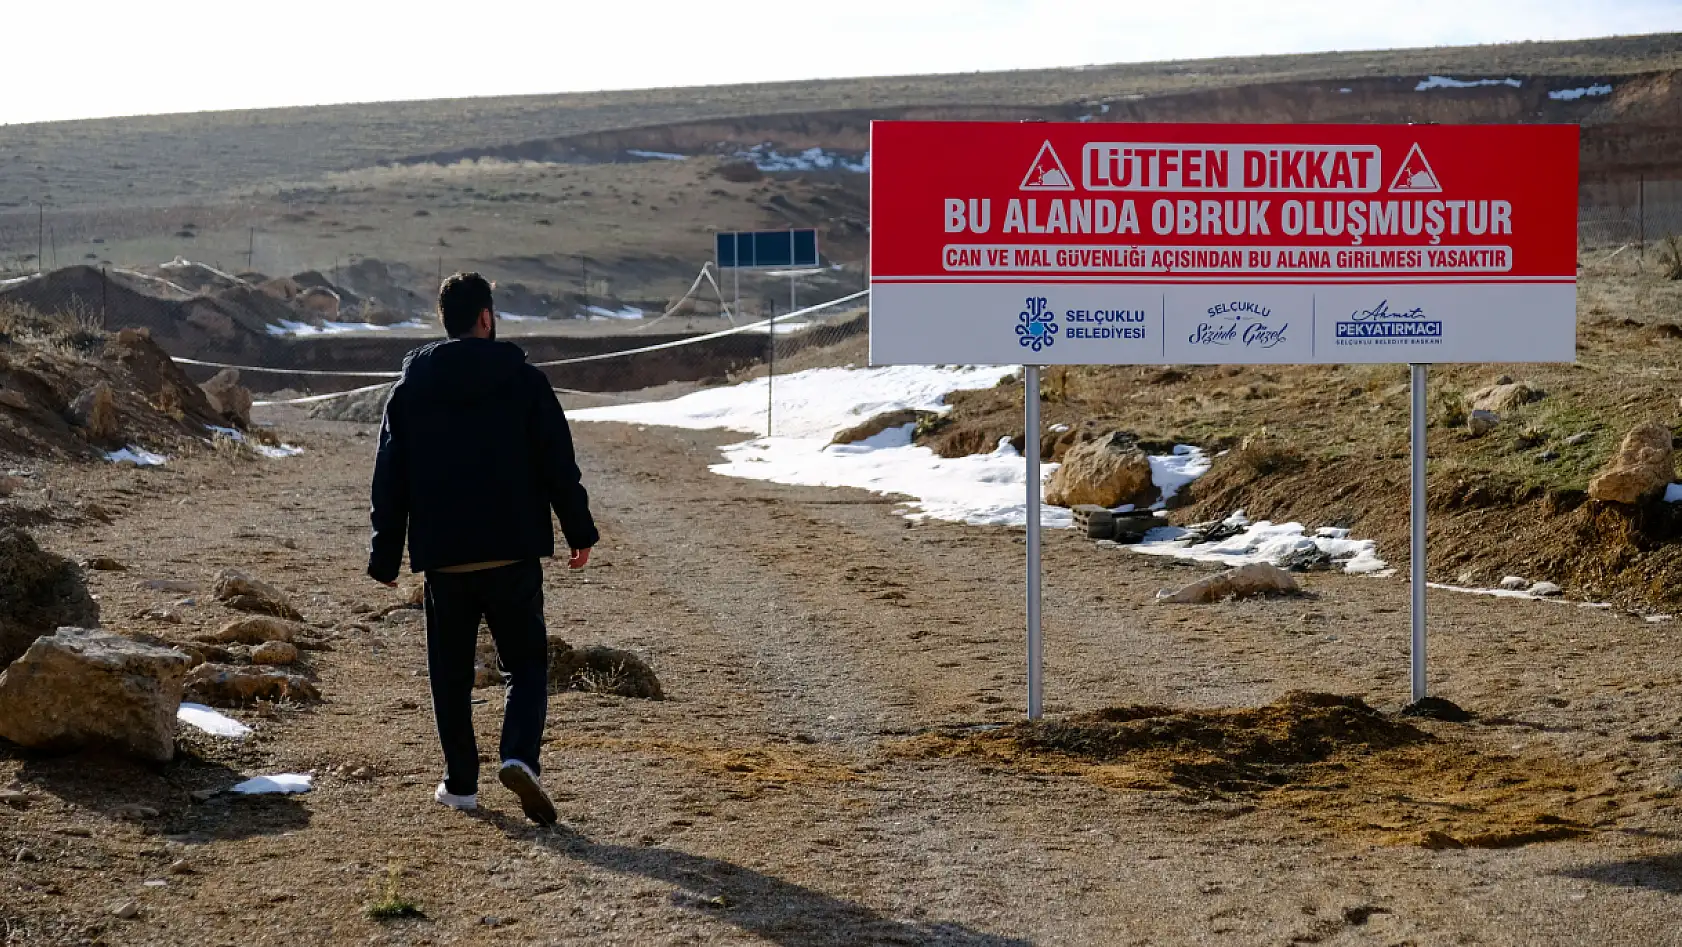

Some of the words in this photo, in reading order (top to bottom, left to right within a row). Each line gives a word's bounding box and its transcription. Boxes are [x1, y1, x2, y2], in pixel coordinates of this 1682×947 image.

[1090, 148, 1228, 187] LÜTFEN
[944, 199, 991, 233] BU
[1002, 199, 1140, 234] ALANDA
[1151, 199, 1271, 235] OBRUK
[1281, 199, 1512, 245] OLUŞMUŞTUR
[946, 249, 982, 267] CAN
[987, 249, 1009, 267] VE
[1014, 249, 1051, 267] MAL
[1151, 249, 1243, 272] AÇISINDAN
[1249, 250, 1271, 268] BU
[1276, 250, 1331, 269] ALANA
[1427, 250, 1506, 268] YASAKTIR
[1065, 310, 1145, 325] SELÇUKLU
[1066, 325, 1146, 339] BELEDİYESİ
[1337, 323, 1440, 335] PEKYATIRMACI
